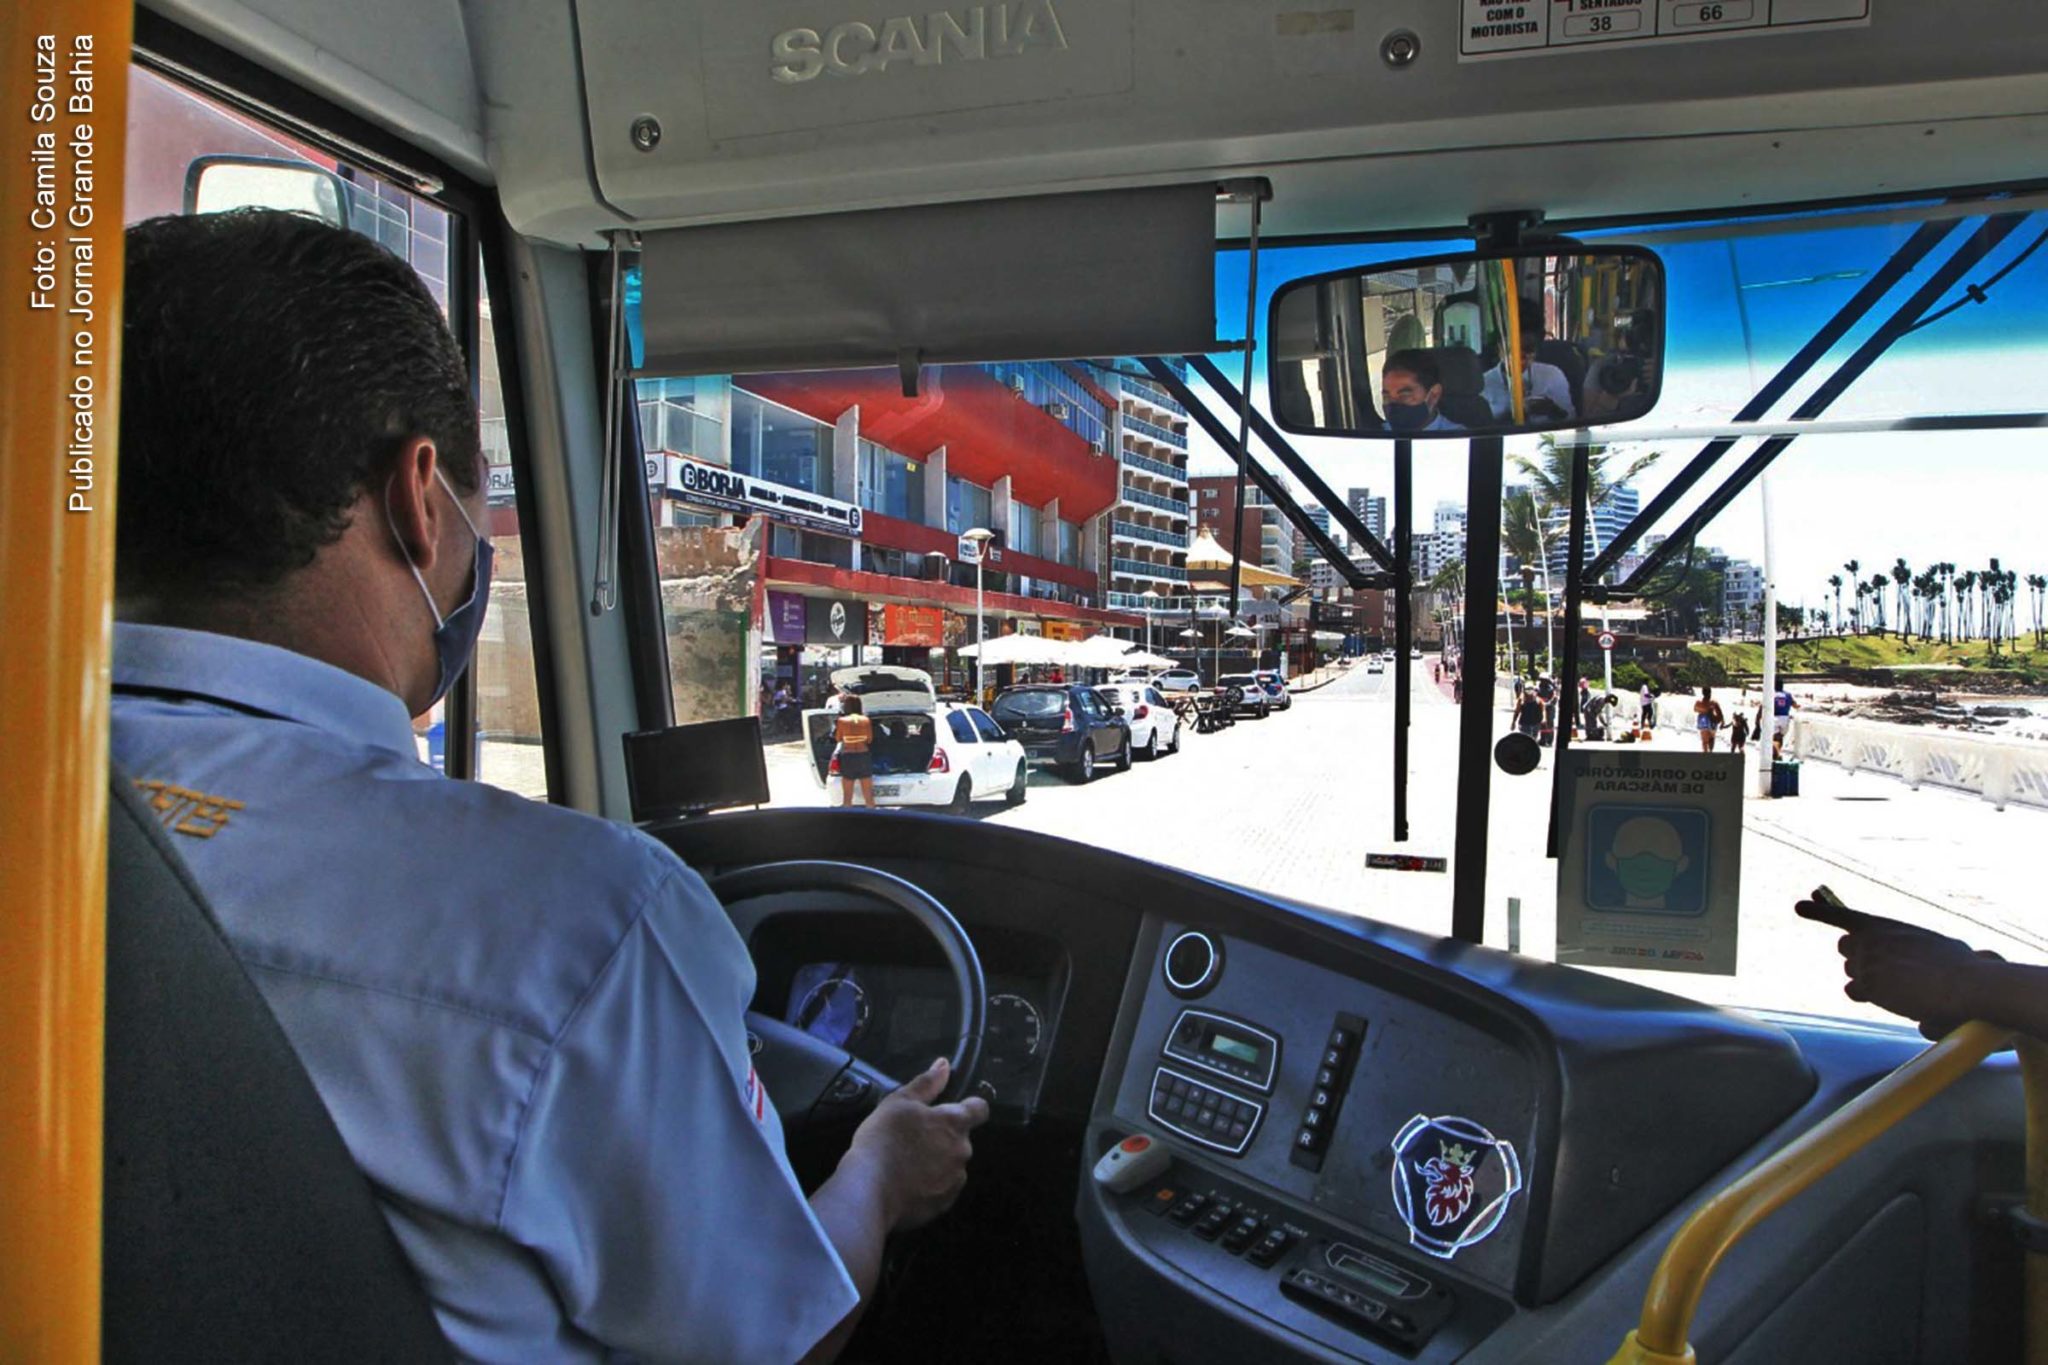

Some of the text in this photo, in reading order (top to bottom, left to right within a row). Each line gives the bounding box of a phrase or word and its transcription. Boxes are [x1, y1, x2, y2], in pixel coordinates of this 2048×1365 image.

[1486, 7, 1525, 22] COM O
[1700, 5, 1722, 21] 66
[1471, 22, 1538, 39] MOTORISTA
[1590, 16, 1612, 32] 38
[772, 0, 1068, 84] SCANIA
[698, 468, 746, 499] BORJA
[1336, 1033, 1342, 1043] 1
[1329, 1051, 1337, 1063] 2
[1322, 1071, 1330, 1083] 3
[1316, 1092, 1327, 1105] D
[1308, 1112, 1319, 1124] N
[1300, 1132, 1311, 1145] R
